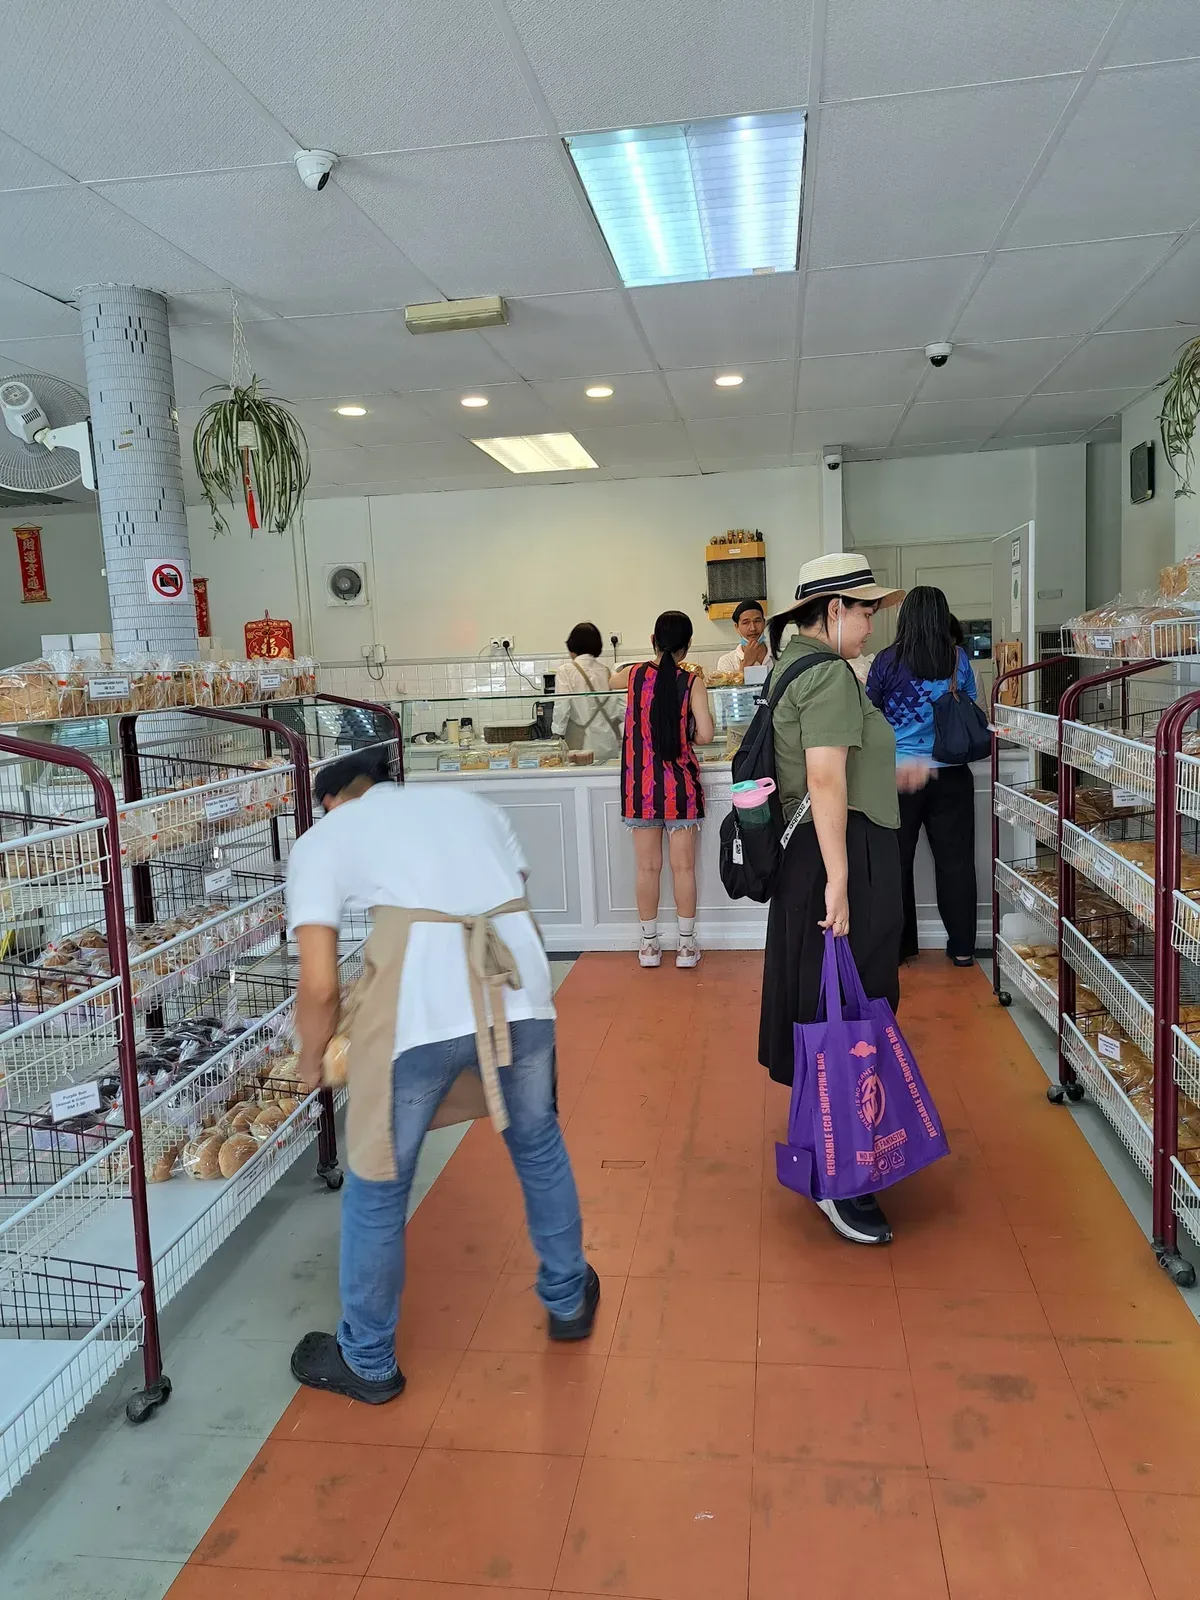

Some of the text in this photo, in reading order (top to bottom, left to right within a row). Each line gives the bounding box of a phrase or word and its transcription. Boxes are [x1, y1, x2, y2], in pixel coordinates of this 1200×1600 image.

[260, 638, 279, 657] 福
[857, 1065, 876, 1086] PLANET
[885, 1026, 938, 1138] REUSABLE ECO SHOPPING BAG
[855, 1088, 861, 1098] NO
[855, 1099, 860, 1107] IS
[816, 1052, 836, 1176] REUSABLE ECO SHOPPING BAG
[857, 1110, 872, 1132] THERE
[880, 1132, 905, 1148] FANTASTIC
